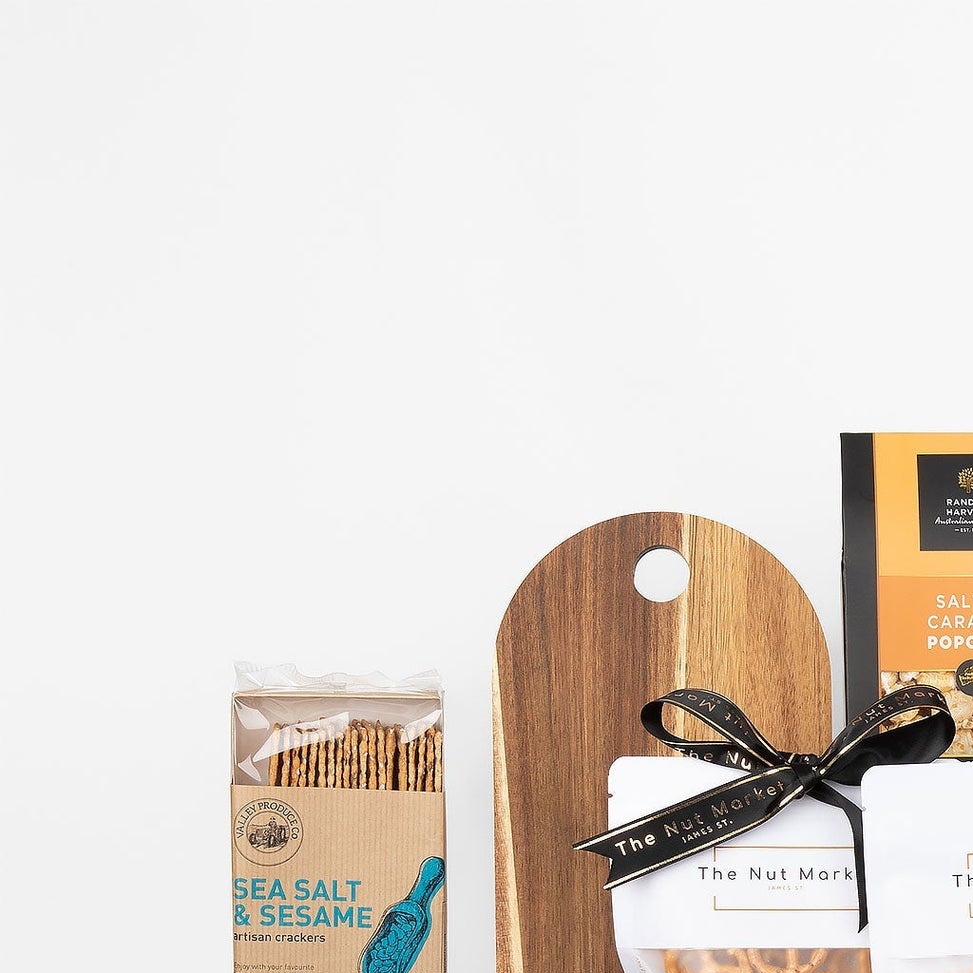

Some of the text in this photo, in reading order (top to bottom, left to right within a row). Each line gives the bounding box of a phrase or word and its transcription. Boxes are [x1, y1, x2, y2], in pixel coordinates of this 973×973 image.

[236, 804, 257, 839] VALLEY
[257, 801, 299, 826] PRODUCE
[614, 780, 784, 856] The Nut Market
[682, 825, 714, 844] JAMES
[698, 866, 853, 881] The Nut Mark
[234, 877, 361, 902] SEA SALT
[234, 904, 372, 928] & SESAME
[233, 932, 326, 943] artisan crackers
